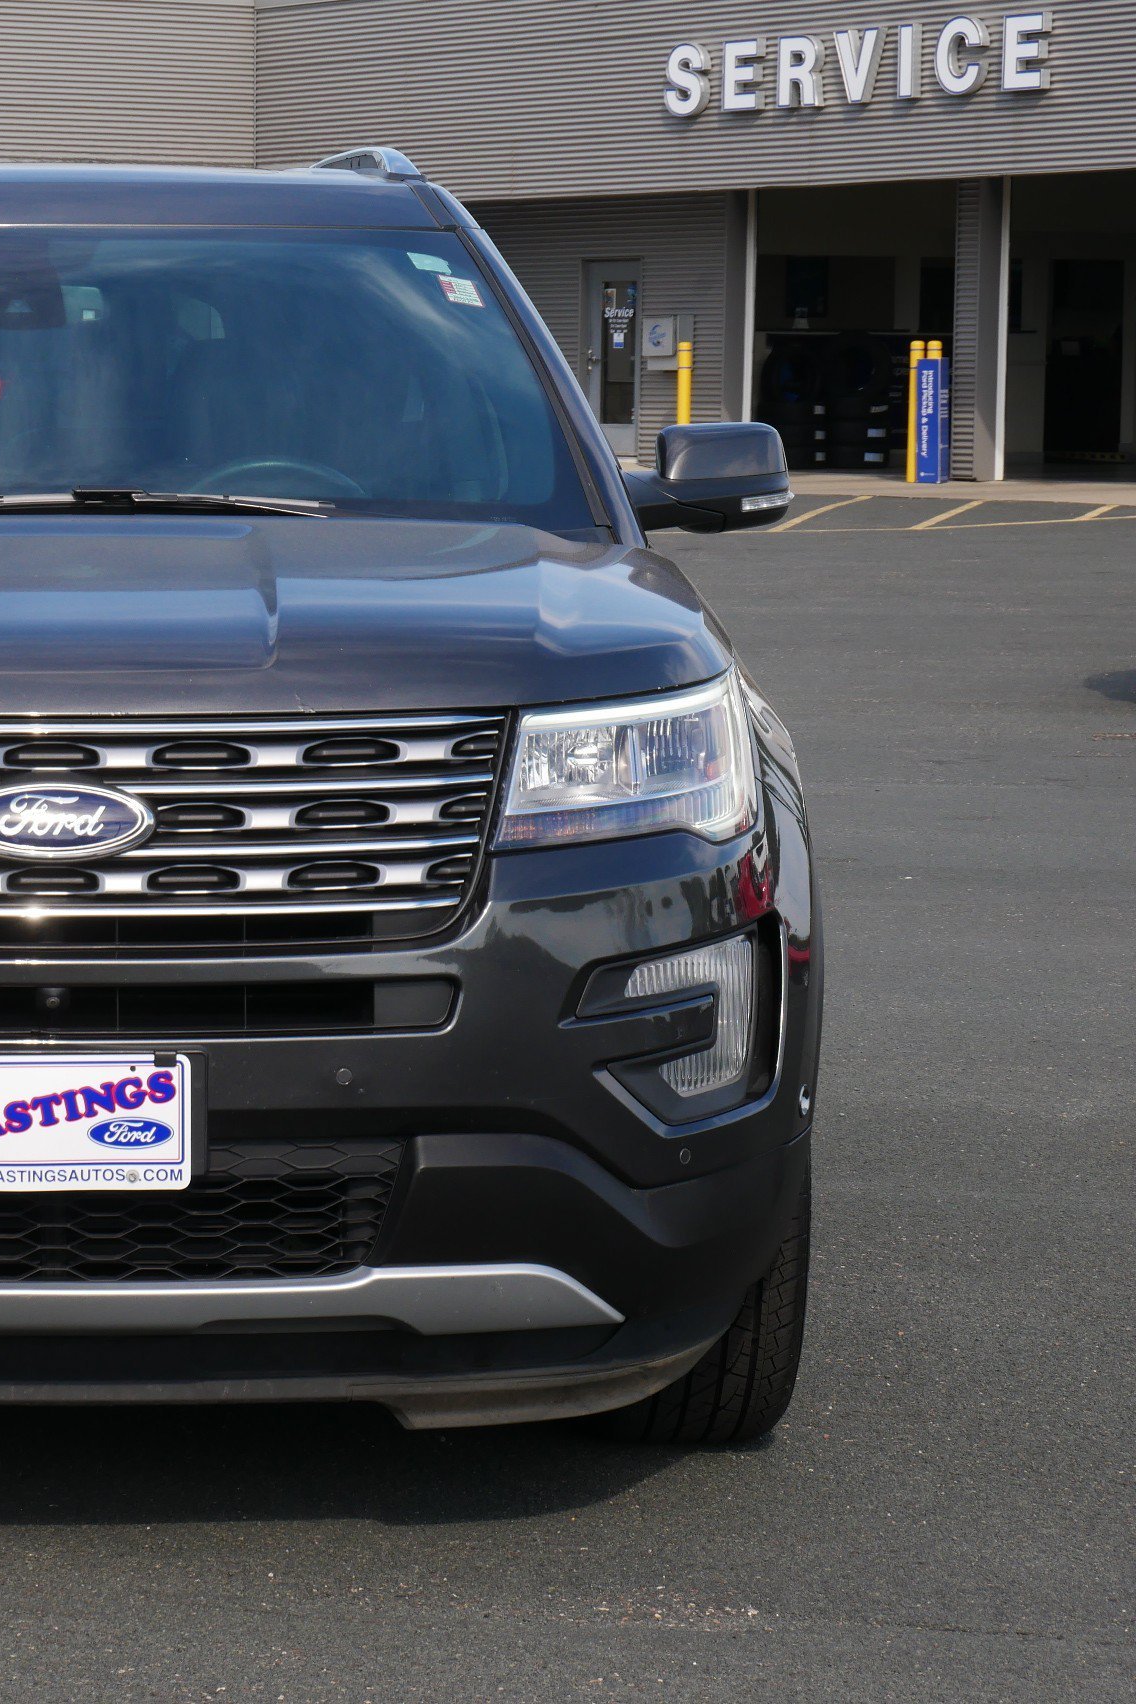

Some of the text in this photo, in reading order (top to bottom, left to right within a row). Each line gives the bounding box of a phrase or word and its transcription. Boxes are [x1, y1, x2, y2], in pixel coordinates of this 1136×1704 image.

[664, 11, 1052, 118] SERVICE
[604, 307, 635, 318] Service
[104, 1121, 157, 1144] Ford
